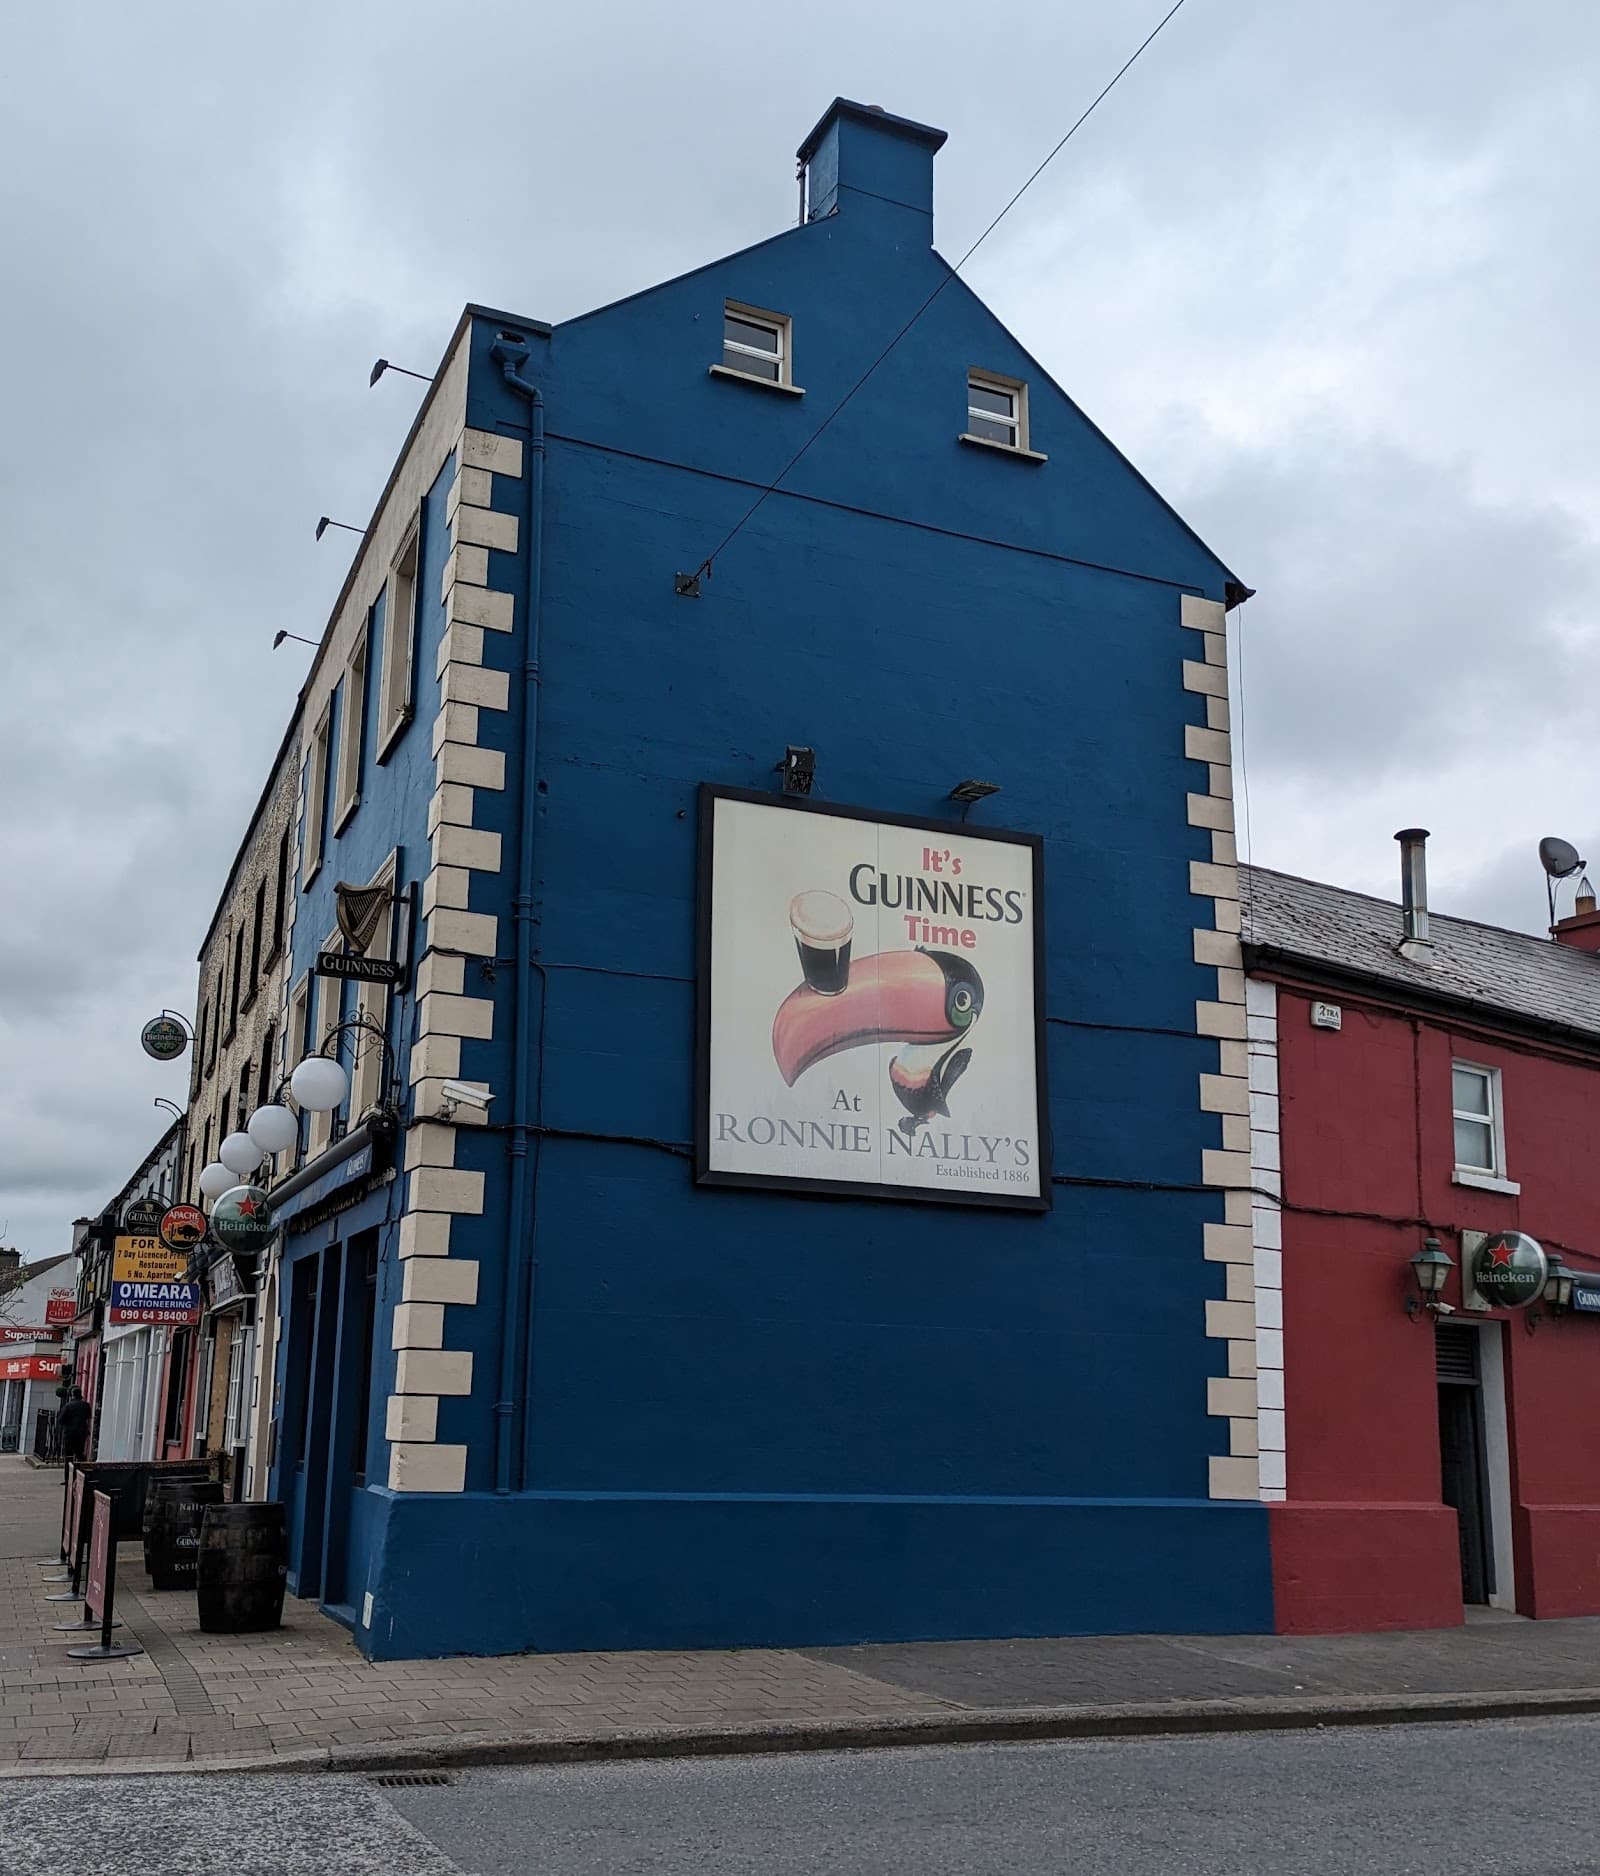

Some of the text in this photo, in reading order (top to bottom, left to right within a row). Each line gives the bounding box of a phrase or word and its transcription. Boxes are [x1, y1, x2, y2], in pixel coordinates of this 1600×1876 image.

[922, 847, 962, 875] It's
[849, 863, 1024, 924] GUINNESS
[903, 915, 977, 949] Time
[322, 954, 395, 978] GUINNESS
[831, 1088, 863, 1113] At
[715, 1112, 1031, 1167] RONNIE NALLY'S
[935, 1163, 1031, 1184] Established 1886
[131, 1239, 154, 1248] FOR
[118, 1250, 122, 1258] 7
[123, 1250, 136, 1261] Day
[139, 1261, 178, 1270] Restaurant
[127, 1271, 132, 1279] 5
[134, 1271, 146, 1279] No.
[1476, 1271, 1536, 1283] Heineken
[120, 1283, 192, 1300] O'MEARA
[119, 1299, 192, 1309] AUCTIONEERING
[120, 1310, 188, 1321] 090 64 38400
[5, 1330, 52, 1340] SuperValu
